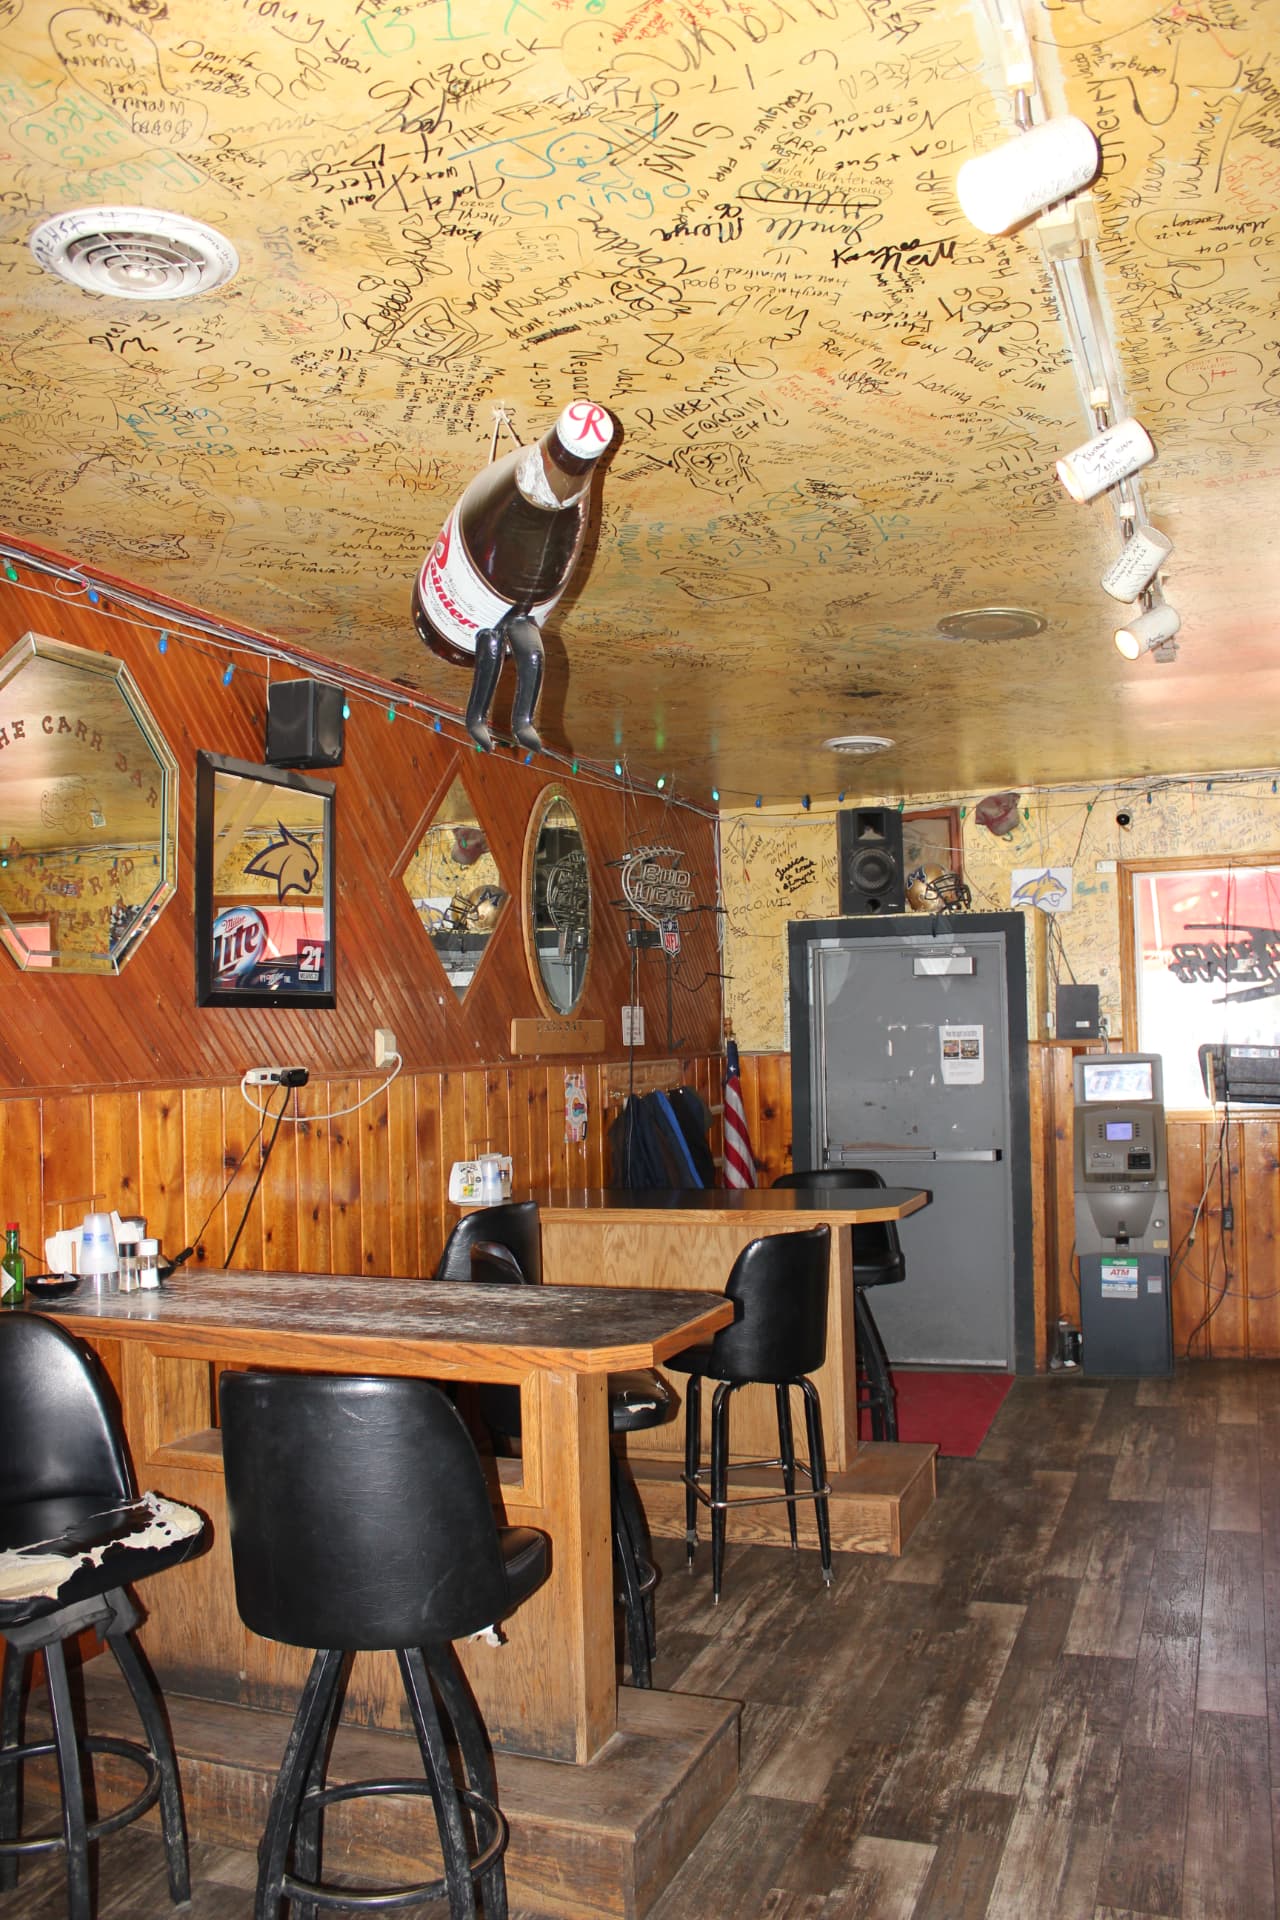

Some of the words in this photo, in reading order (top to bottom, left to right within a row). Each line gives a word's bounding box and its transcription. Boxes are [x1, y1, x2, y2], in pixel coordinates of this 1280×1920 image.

[0, 719, 26, 748] HE
[41, 714, 104, 752] CARR
[113, 751, 160, 809] BAR
[642, 863, 692, 888] BUD
[631, 881, 696, 907] LIGHT
[213, 922, 261, 973] Lite
[663, 932, 679, 951] NFL
[299, 945, 323, 972] 21
[1109, 1268, 1130, 1276] ATM
